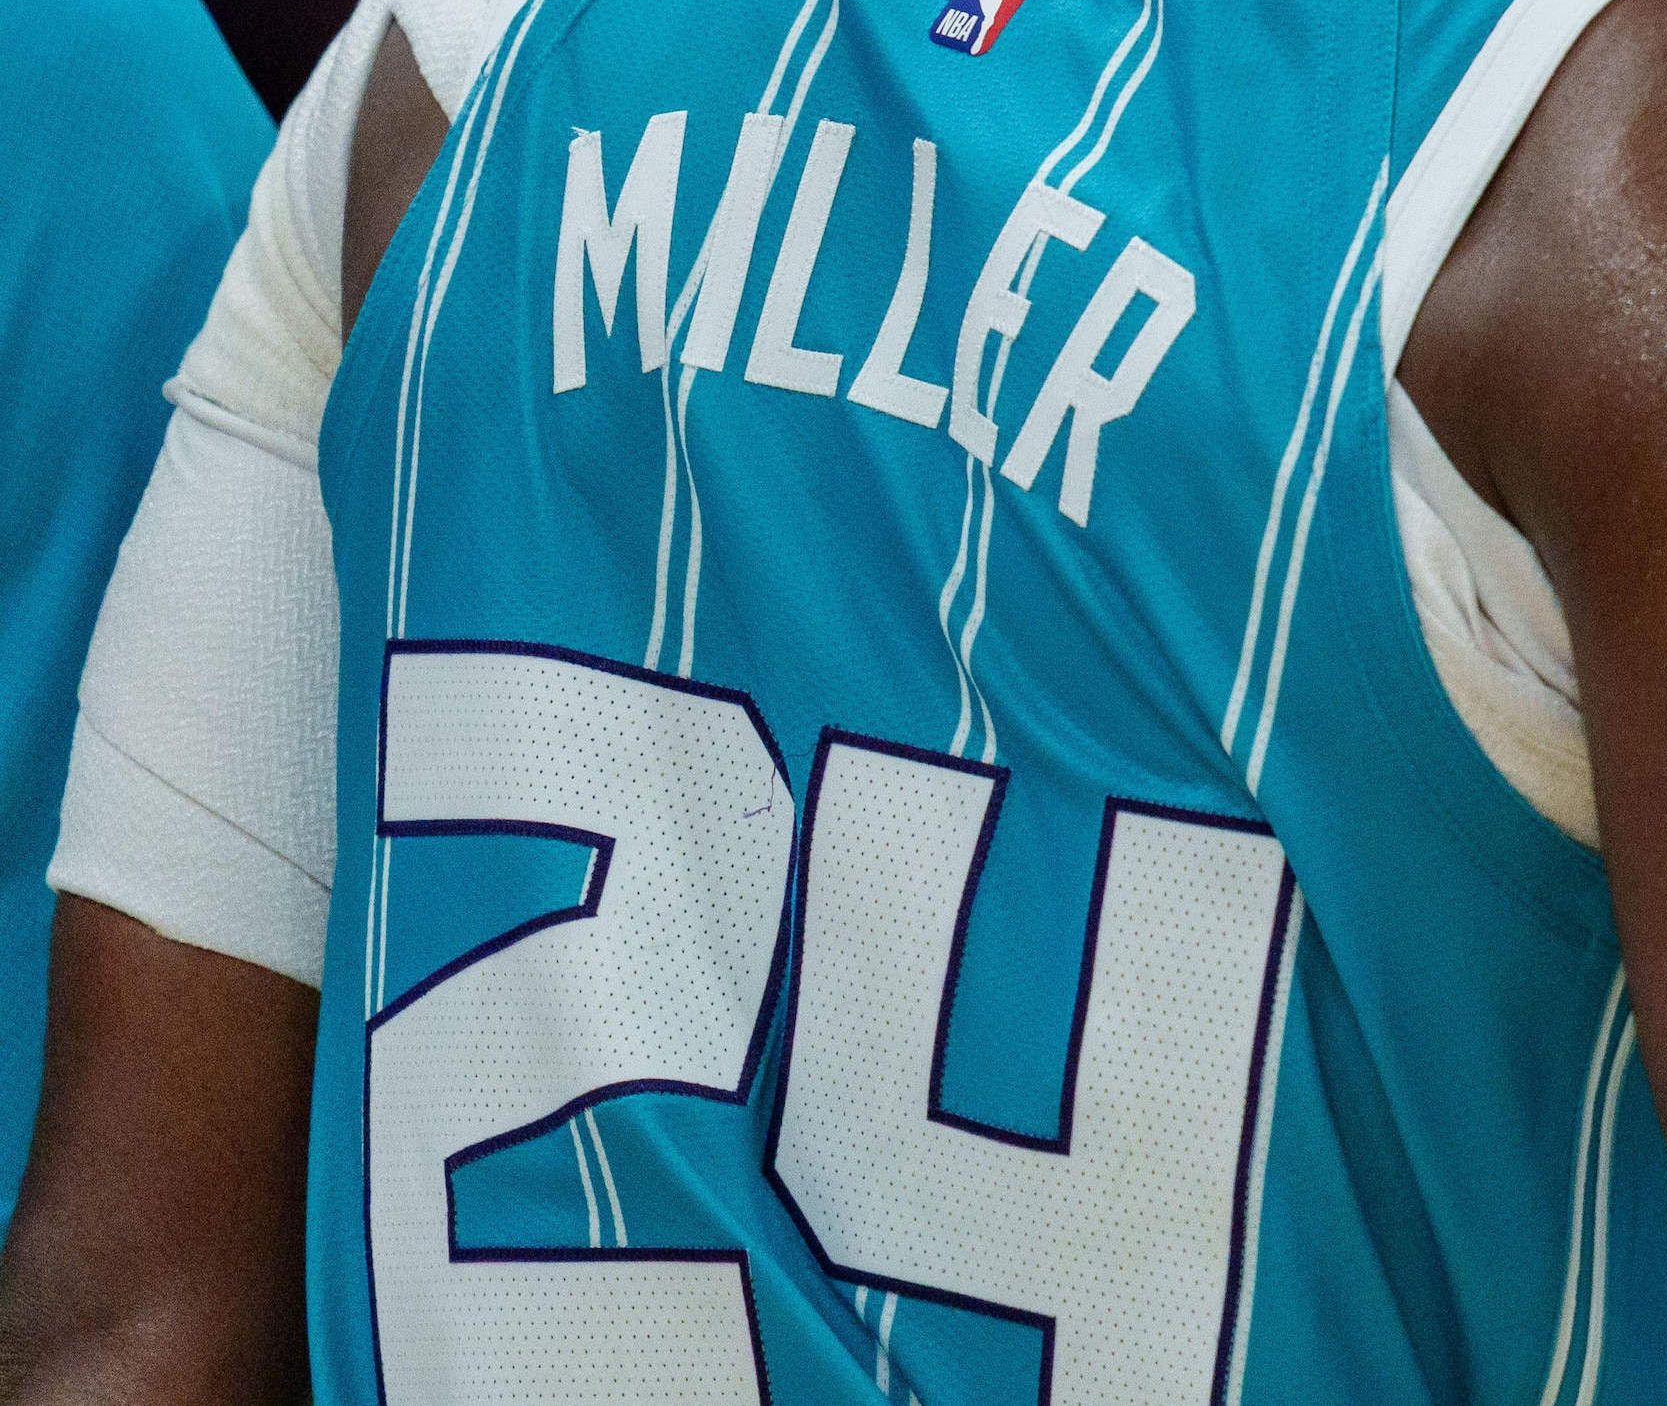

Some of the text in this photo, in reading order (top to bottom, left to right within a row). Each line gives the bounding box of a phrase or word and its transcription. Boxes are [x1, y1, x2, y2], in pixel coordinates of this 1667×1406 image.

[935, 8, 979, 43] NBA
[552, 109, 1198, 528] MILLER
[362, 638, 1300, 1406] 24
